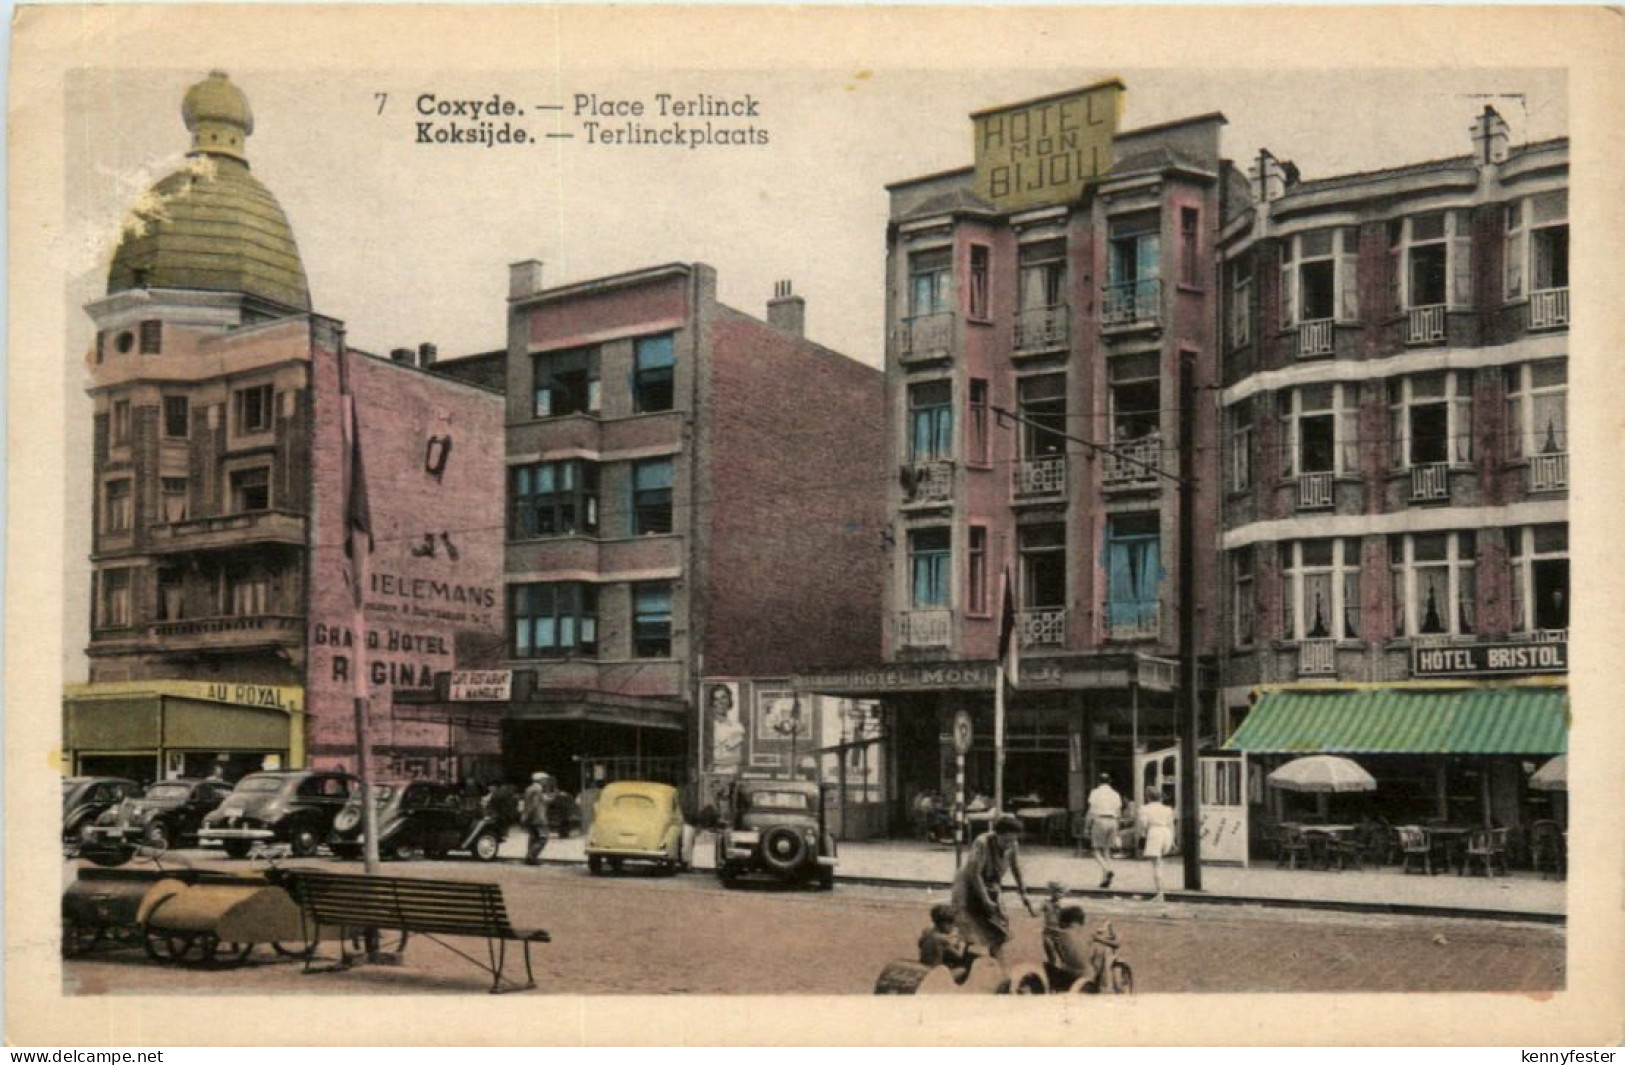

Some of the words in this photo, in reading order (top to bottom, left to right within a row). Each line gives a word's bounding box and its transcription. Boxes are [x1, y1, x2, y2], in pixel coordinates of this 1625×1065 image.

[982, 94, 1104, 150] HOTEL
[1010, 131, 1077, 163] MON
[990, 146, 1098, 198] BIJOU
[314, 622, 379, 649] GRAD
[387, 628, 449, 655] HOTEL
[332, 655, 433, 687] RGINA
[1488, 646, 1564, 668] BRISTOL
[921, 668, 980, 684] MON
[207, 684, 227, 700] AU
[235, 685, 287, 708] ROYAL
